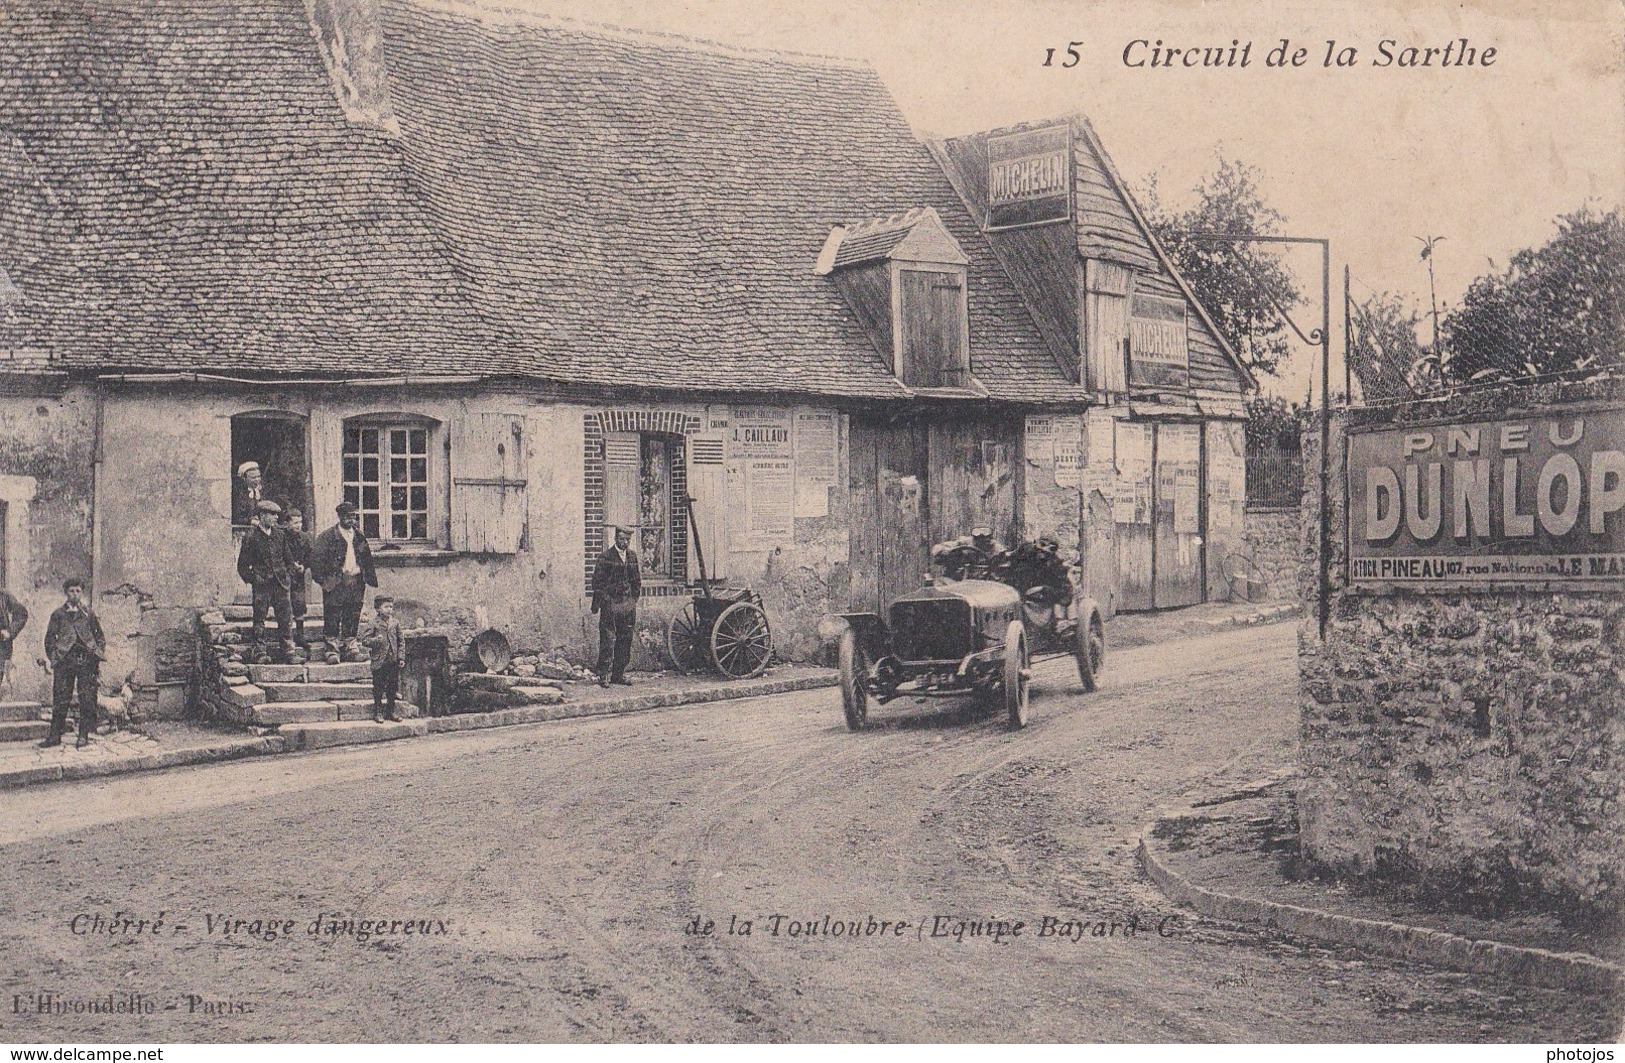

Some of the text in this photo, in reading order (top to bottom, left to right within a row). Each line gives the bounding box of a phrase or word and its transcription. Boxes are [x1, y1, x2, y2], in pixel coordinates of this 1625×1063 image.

[991, 154, 1065, 199] MICHELIN
[1132, 321, 1187, 359] MICHELIN
[745, 428, 789, 442] CAILLAUX
[1404, 417, 1585, 459] PNEU
[1366, 450, 1625, 545] DUNLOP
[1353, 559, 1378, 578] STOCK
[1465, 563, 1489, 574] rue
[1558, 557, 1582, 576] LE
[1588, 556, 1625, 576] MA
